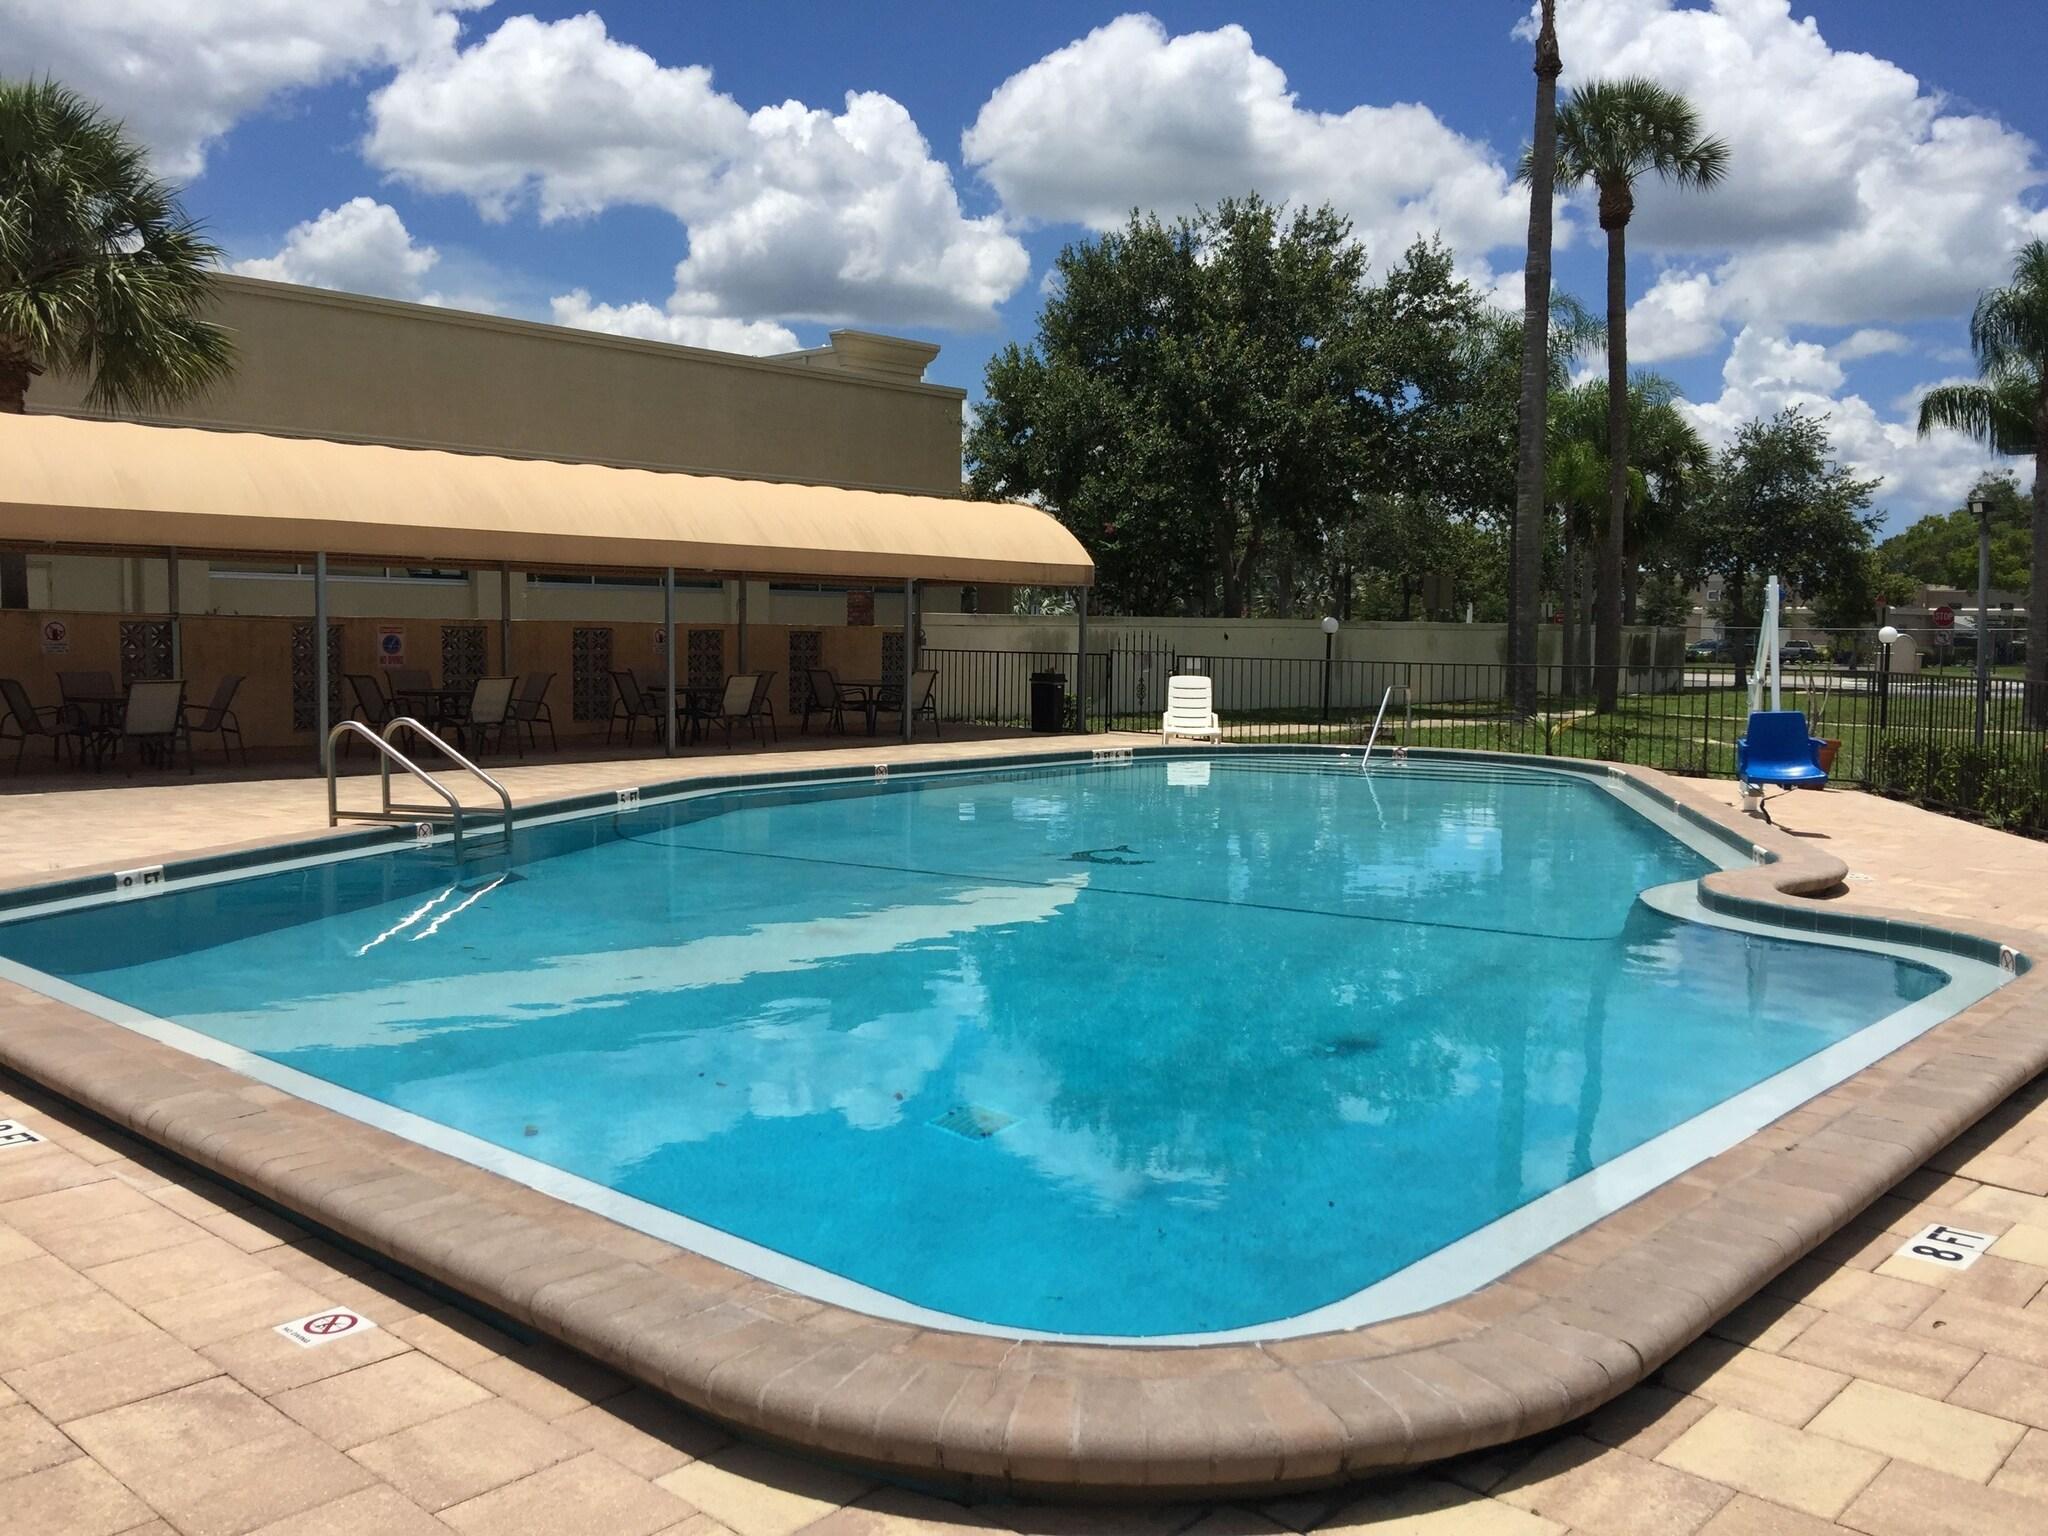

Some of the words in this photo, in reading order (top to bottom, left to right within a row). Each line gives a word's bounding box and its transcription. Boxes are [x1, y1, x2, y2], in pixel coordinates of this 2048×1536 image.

[1935, 612, 1953, 621] STOP
[144, 871, 160, 885] FT
[1926, 1226, 1984, 1248] FT
[1912, 1245, 1963, 1261] 8
[290, 1331, 311, 1344] DIVING
